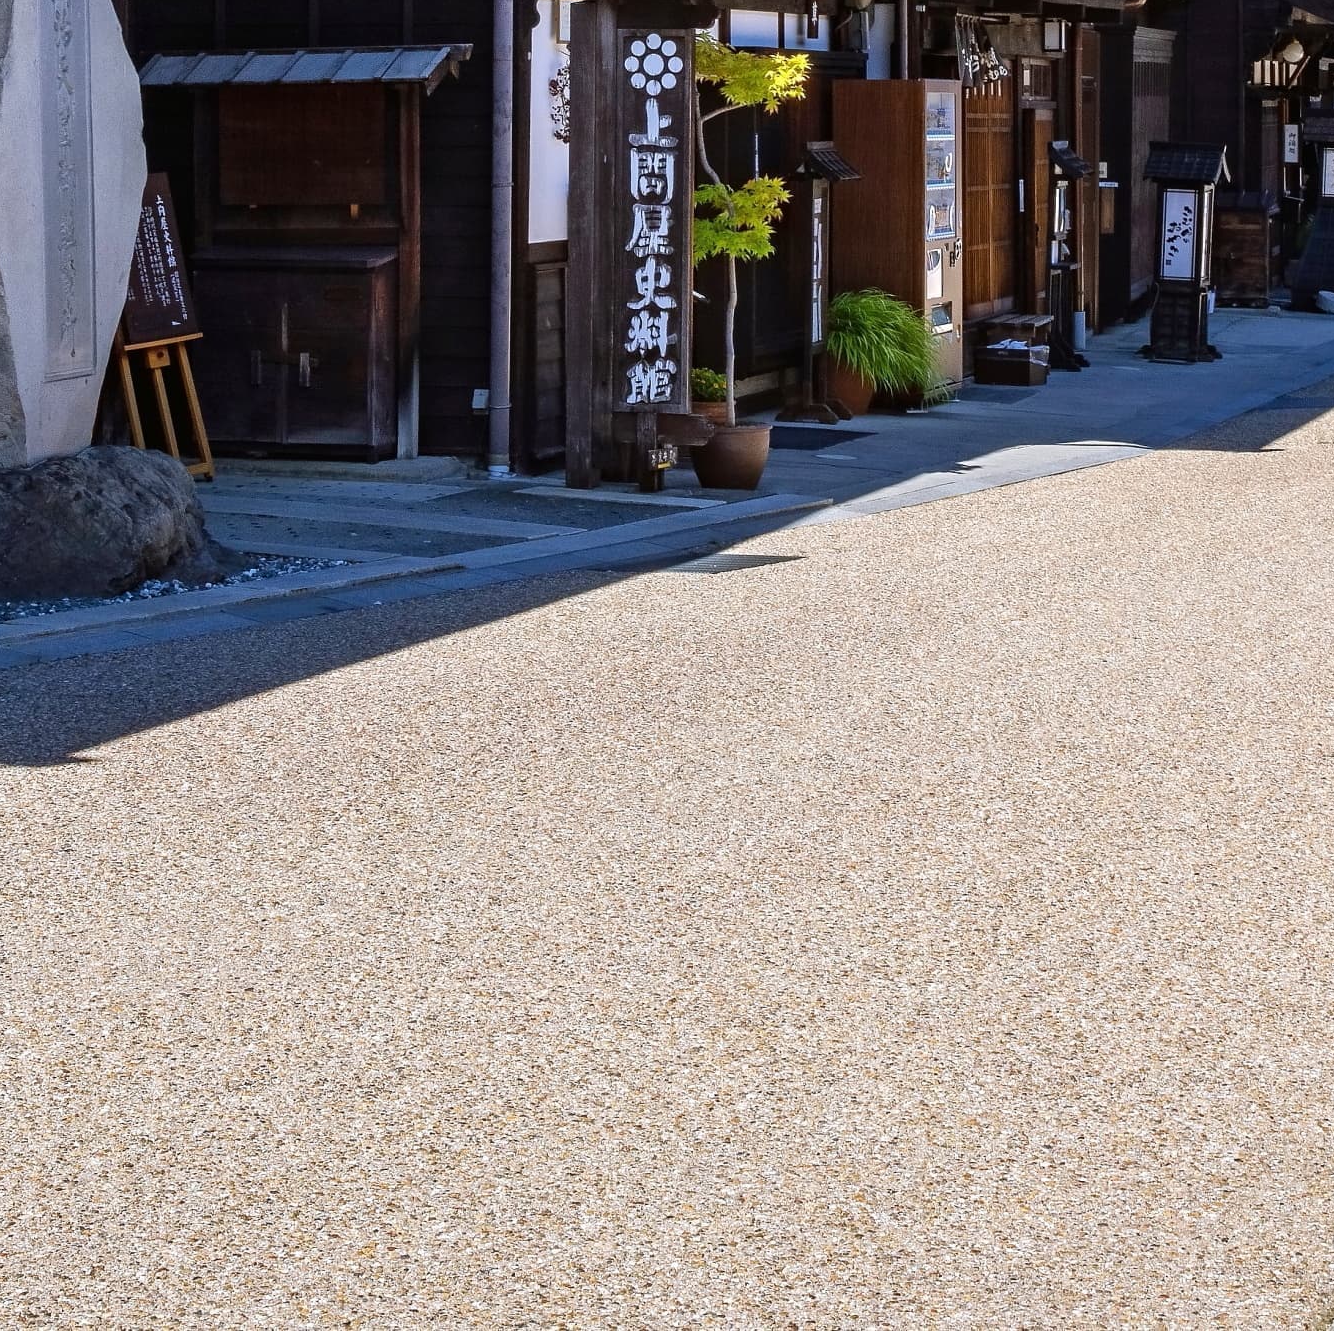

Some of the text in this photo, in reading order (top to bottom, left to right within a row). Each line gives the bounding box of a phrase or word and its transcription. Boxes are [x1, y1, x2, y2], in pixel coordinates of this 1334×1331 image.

[624, 97, 680, 406] 上問屋史料館
